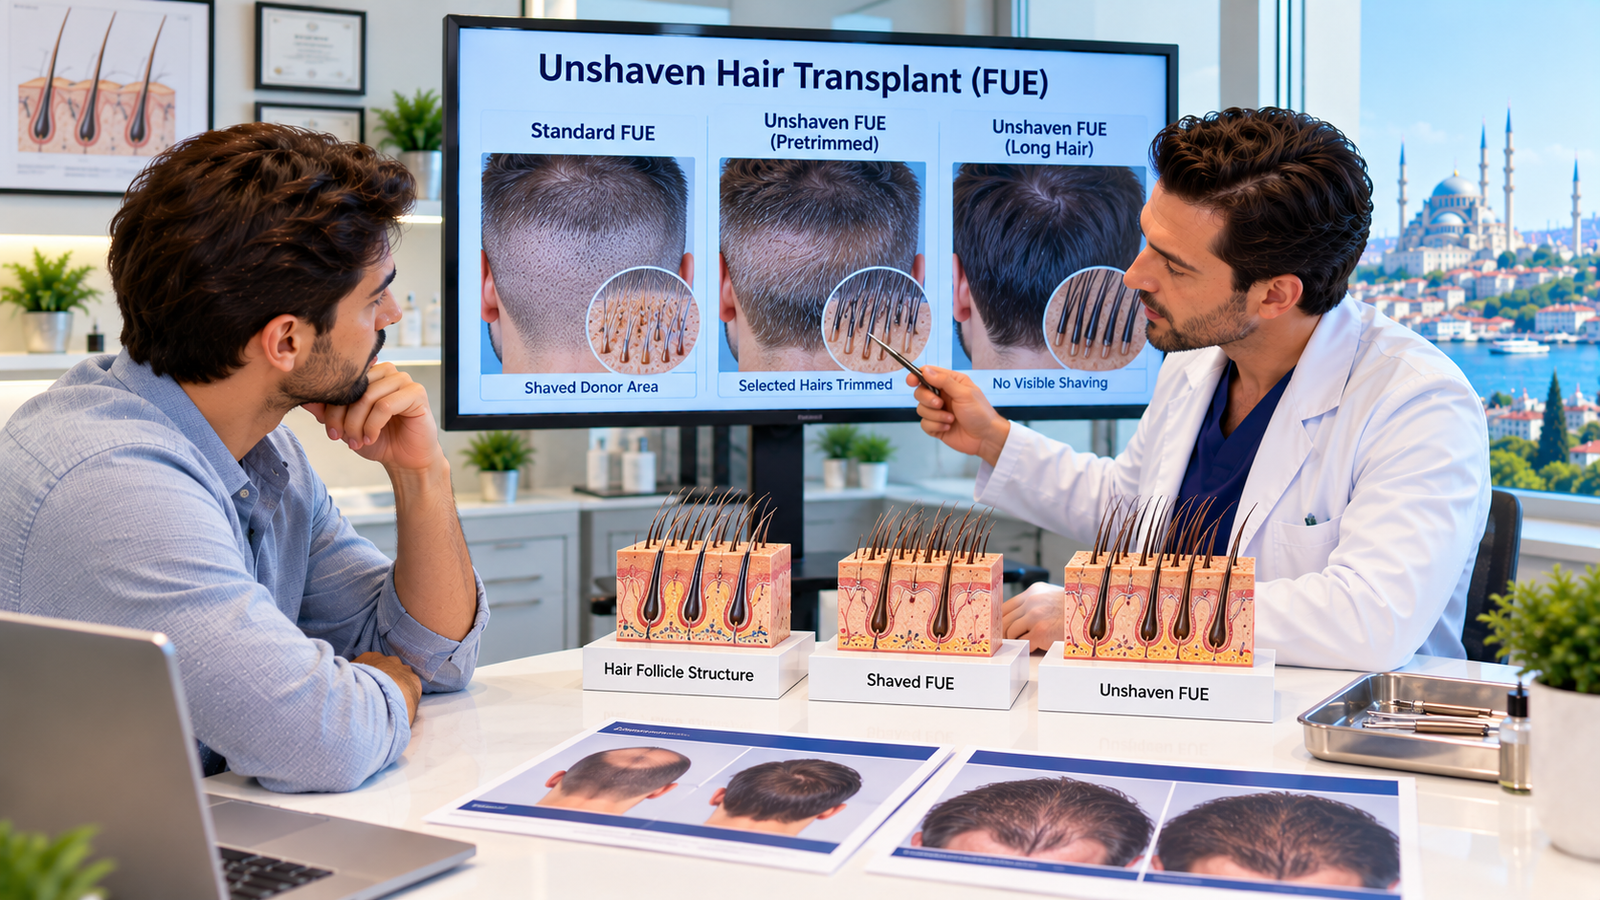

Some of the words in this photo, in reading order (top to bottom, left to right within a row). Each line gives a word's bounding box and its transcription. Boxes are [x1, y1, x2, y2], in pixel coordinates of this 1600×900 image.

[539, 52, 706, 86] Unshaven
[717, 58, 785, 88] Hair
[792, 61, 962, 98] Transplant
[971, 65, 1049, 101] (FUE)
[764, 112, 849, 130] Unshaven
[854, 114, 887, 131] FUE
[992, 118, 1072, 136] Unshaven
[1076, 120, 1108, 137] FUE
[531, 121, 615, 141] Standard
[620, 124, 656, 142] FUE
[770, 132, 879, 155] (Pretrimmed)
[1004, 138, 1051, 159] (Long
[1055, 140, 1094, 159] Hair)
[524, 380, 576, 394] Shaved
[580, 380, 624, 394] Donor
[626, 380, 659, 393] Area
[738, 378, 796, 392] Selected
[799, 378, 833, 391] Hairs
[835, 377, 893, 391] Trimmed
[992, 377, 1011, 390] No
[1014, 376, 1056, 390] Visible
[1058, 376, 1108, 392] Shaving
[604, 662, 633, 677] Hair
[636, 663, 685, 679] Follicle
[688, 665, 755, 682] Structure
[867, 672, 921, 689] Shaved
[925, 675, 955, 691] FUE
[1100, 682, 1174, 701] Unshaven
[1179, 686, 1209, 702] FUE
